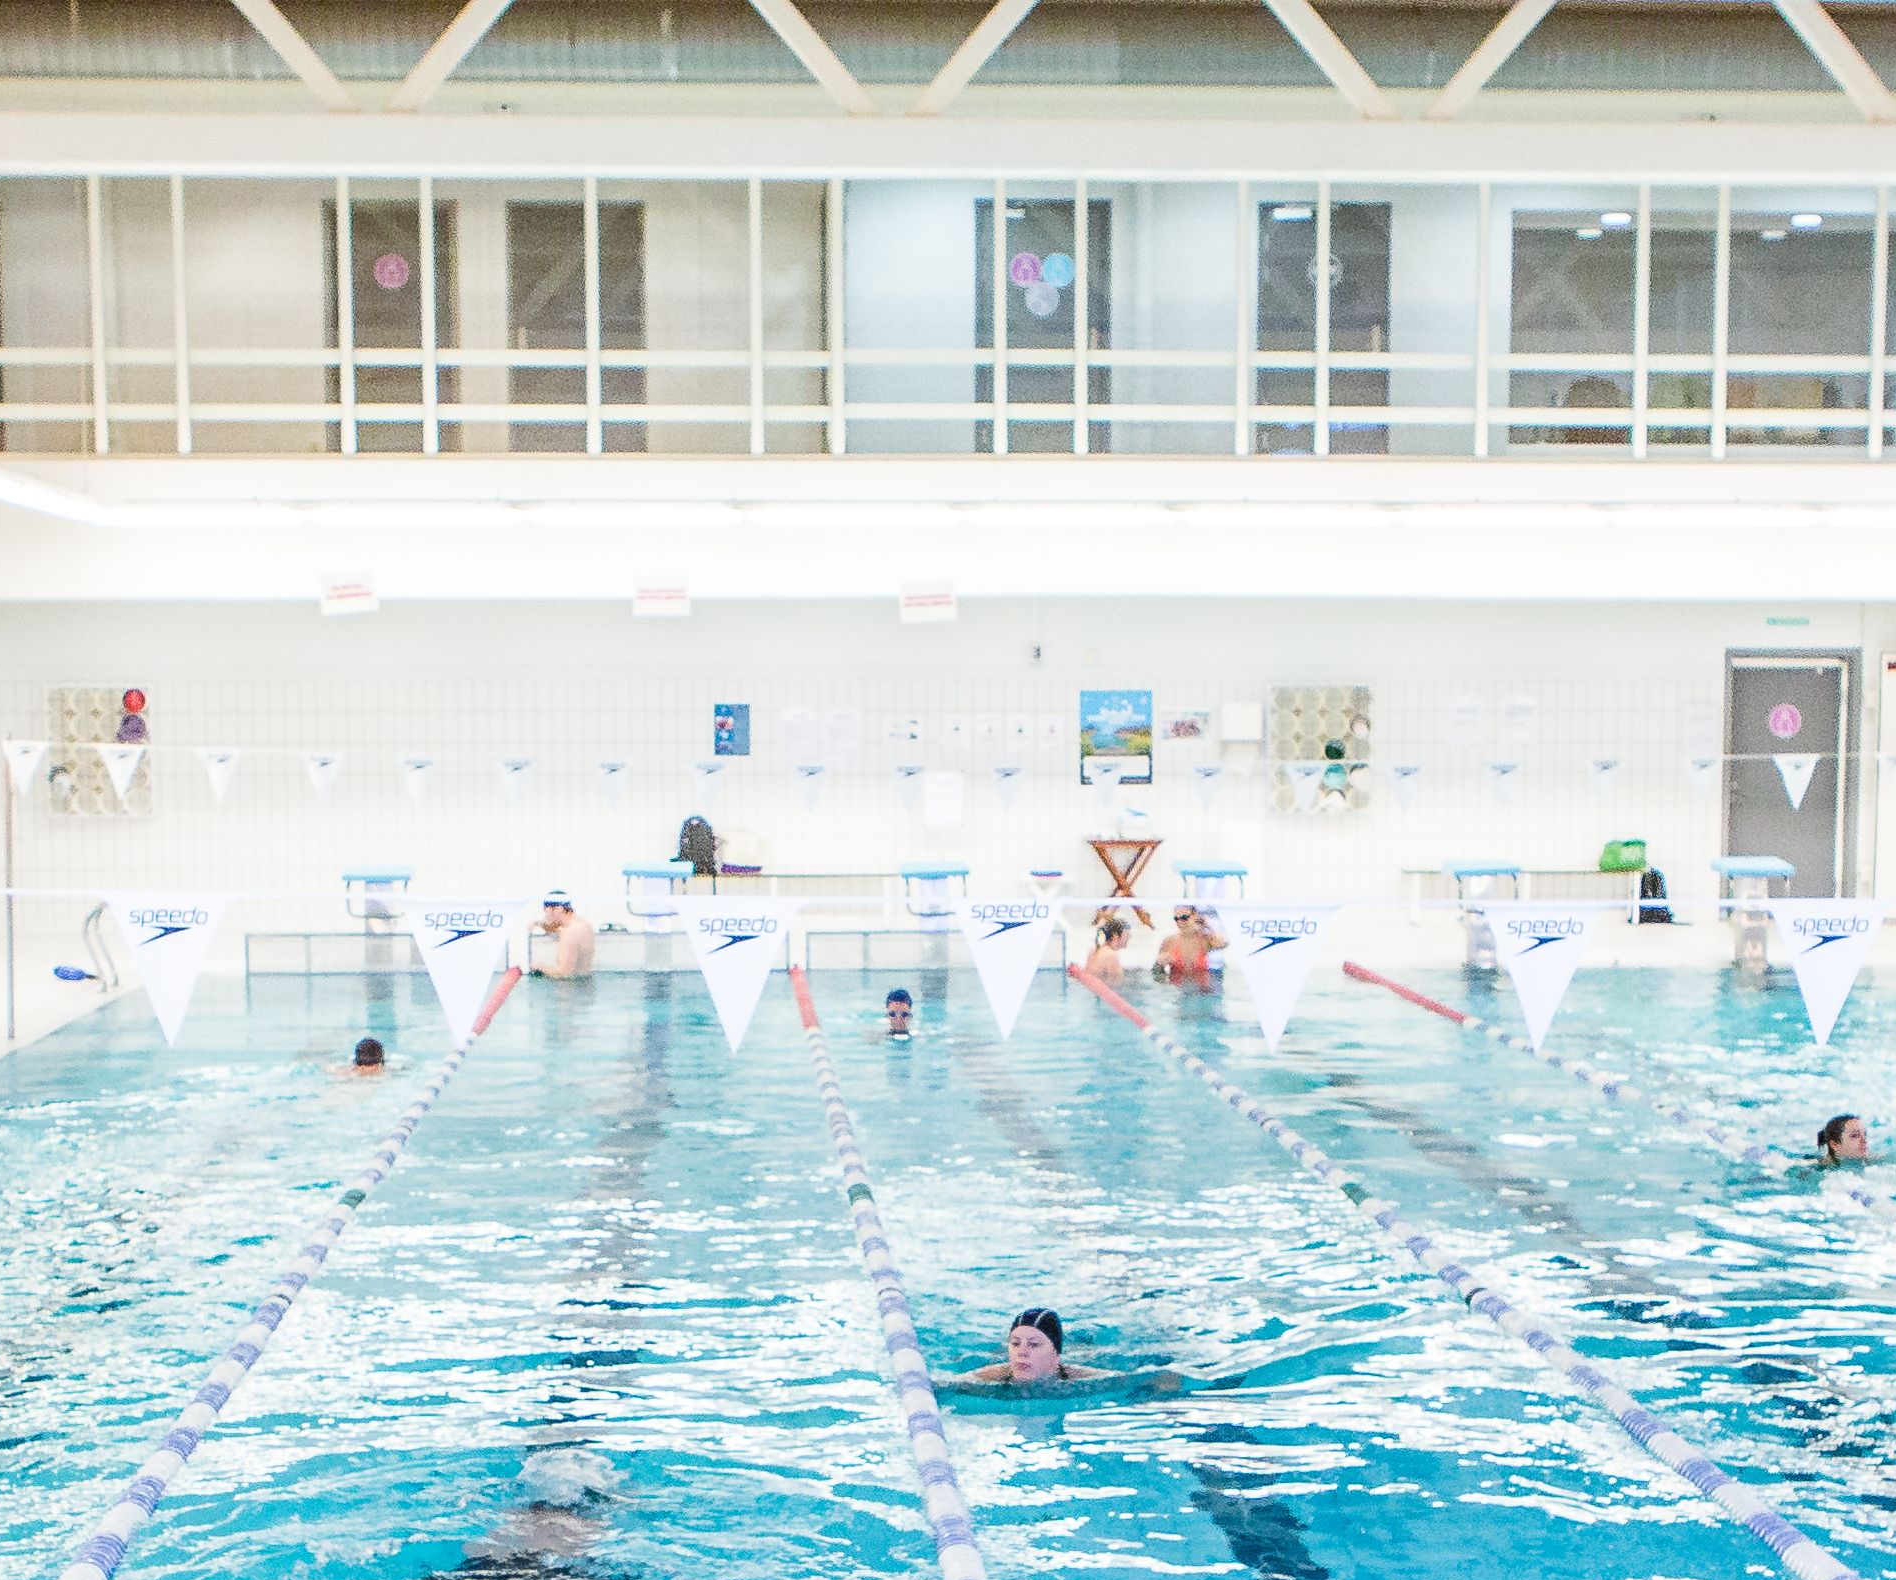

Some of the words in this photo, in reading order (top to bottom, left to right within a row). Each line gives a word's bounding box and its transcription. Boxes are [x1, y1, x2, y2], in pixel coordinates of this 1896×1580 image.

[129, 907, 209, 928] speedo
[424, 906, 503, 928] speedo
[971, 903, 1049, 923] speedo
[699, 914, 778, 935] speedo
[1240, 917, 1317, 937] speedo
[1507, 917, 1584, 937] speedo
[1793, 916, 1870, 936] speedo
